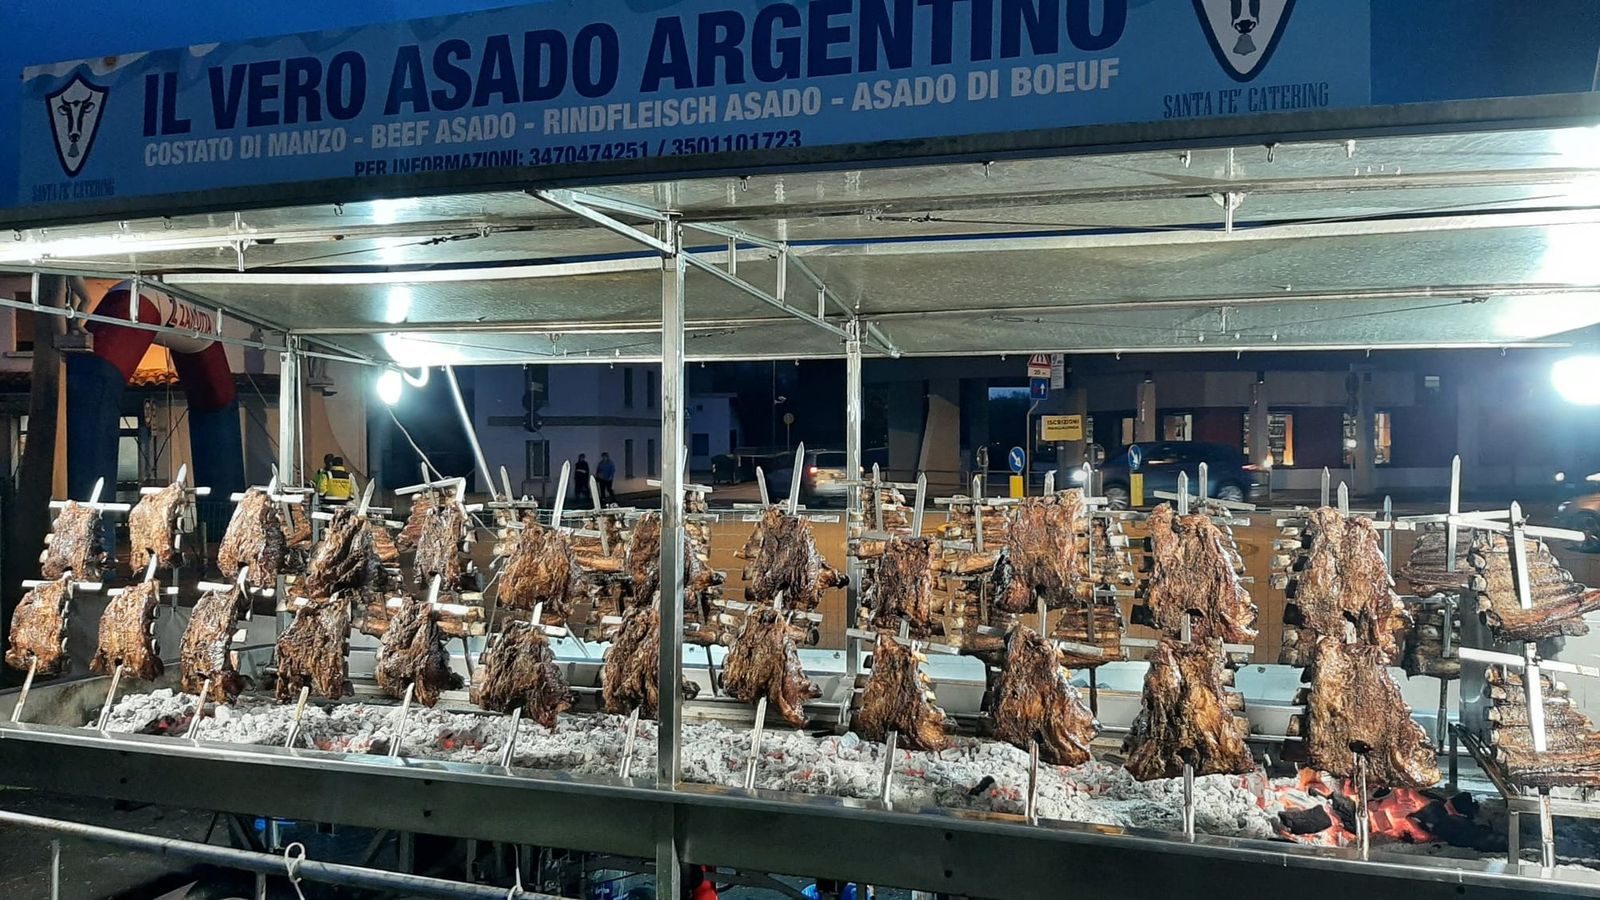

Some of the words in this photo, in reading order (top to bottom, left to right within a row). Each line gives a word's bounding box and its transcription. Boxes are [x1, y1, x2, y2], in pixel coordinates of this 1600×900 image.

[143, 71, 191, 137] IL
[208, 50, 366, 130] VERO
[384, 22, 620, 115] ASADO
[640, 0, 1127, 93] ARGENTINO
[1163, 90, 1212, 119] SANTA
[1248, 81, 1329, 112] CATERING
[144, 136, 233, 167] COSTATO
[240, 133, 261, 160] DI
[268, 127, 347, 157] MANZO
[371, 120, 429, 149] BEEF
[435, 111, 516, 144] ASADO
[543, 95, 717, 135] RINDFLEISCH
[724, 86, 821, 122] ASADO
[851, 73, 957, 112] ASADO
[967, 69, 998, 100] DI
[1010, 57, 1120, 97] BOEUF
[354, 159, 387, 176] PER
[529, 140, 648, 166] 3470474251
